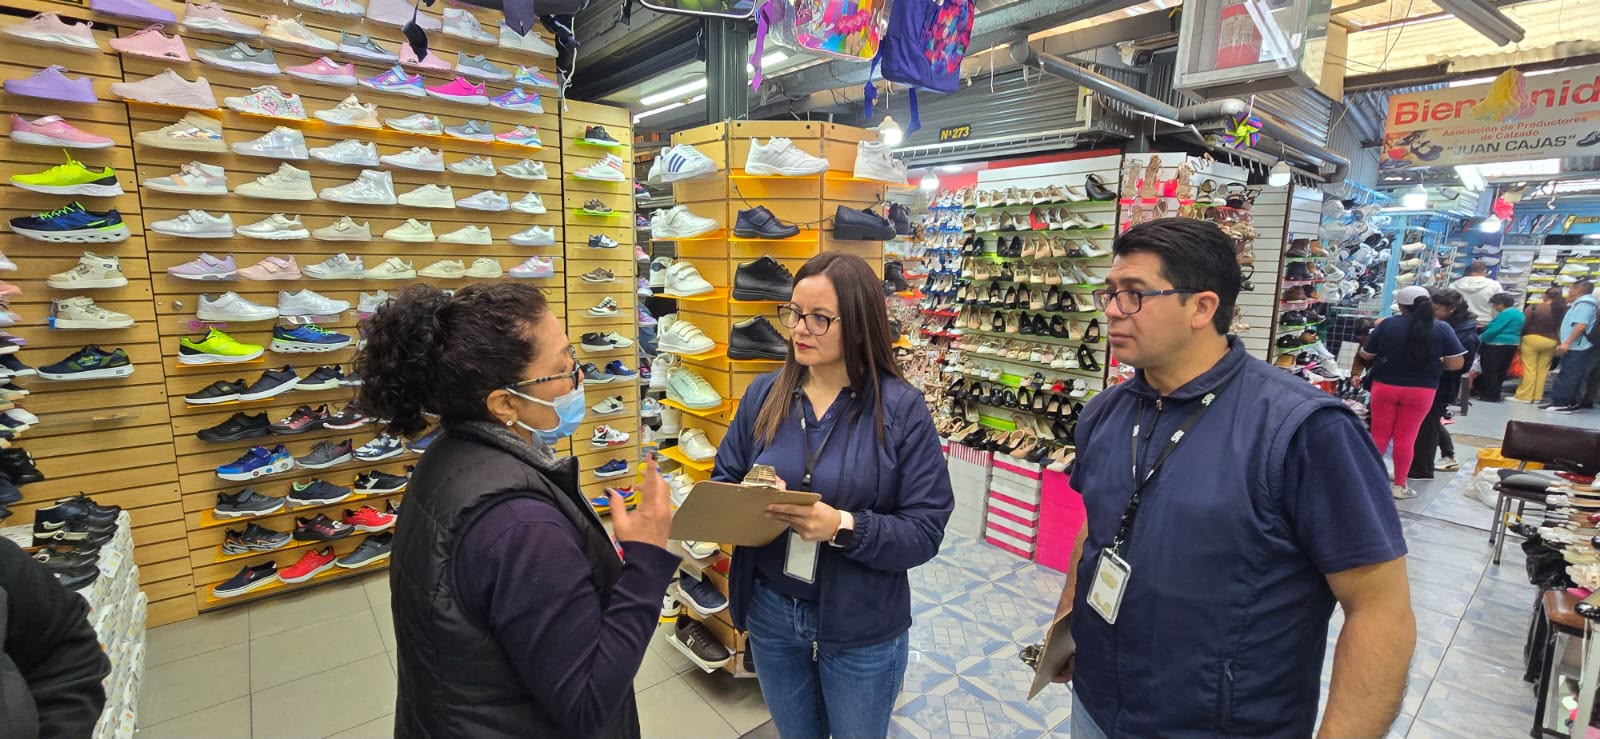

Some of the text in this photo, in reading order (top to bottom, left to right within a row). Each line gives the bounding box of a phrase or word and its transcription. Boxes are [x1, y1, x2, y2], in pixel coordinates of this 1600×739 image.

[1442, 116, 1588, 137] Asociación de Productores
[1495, 130, 1540, 140] Calzado
